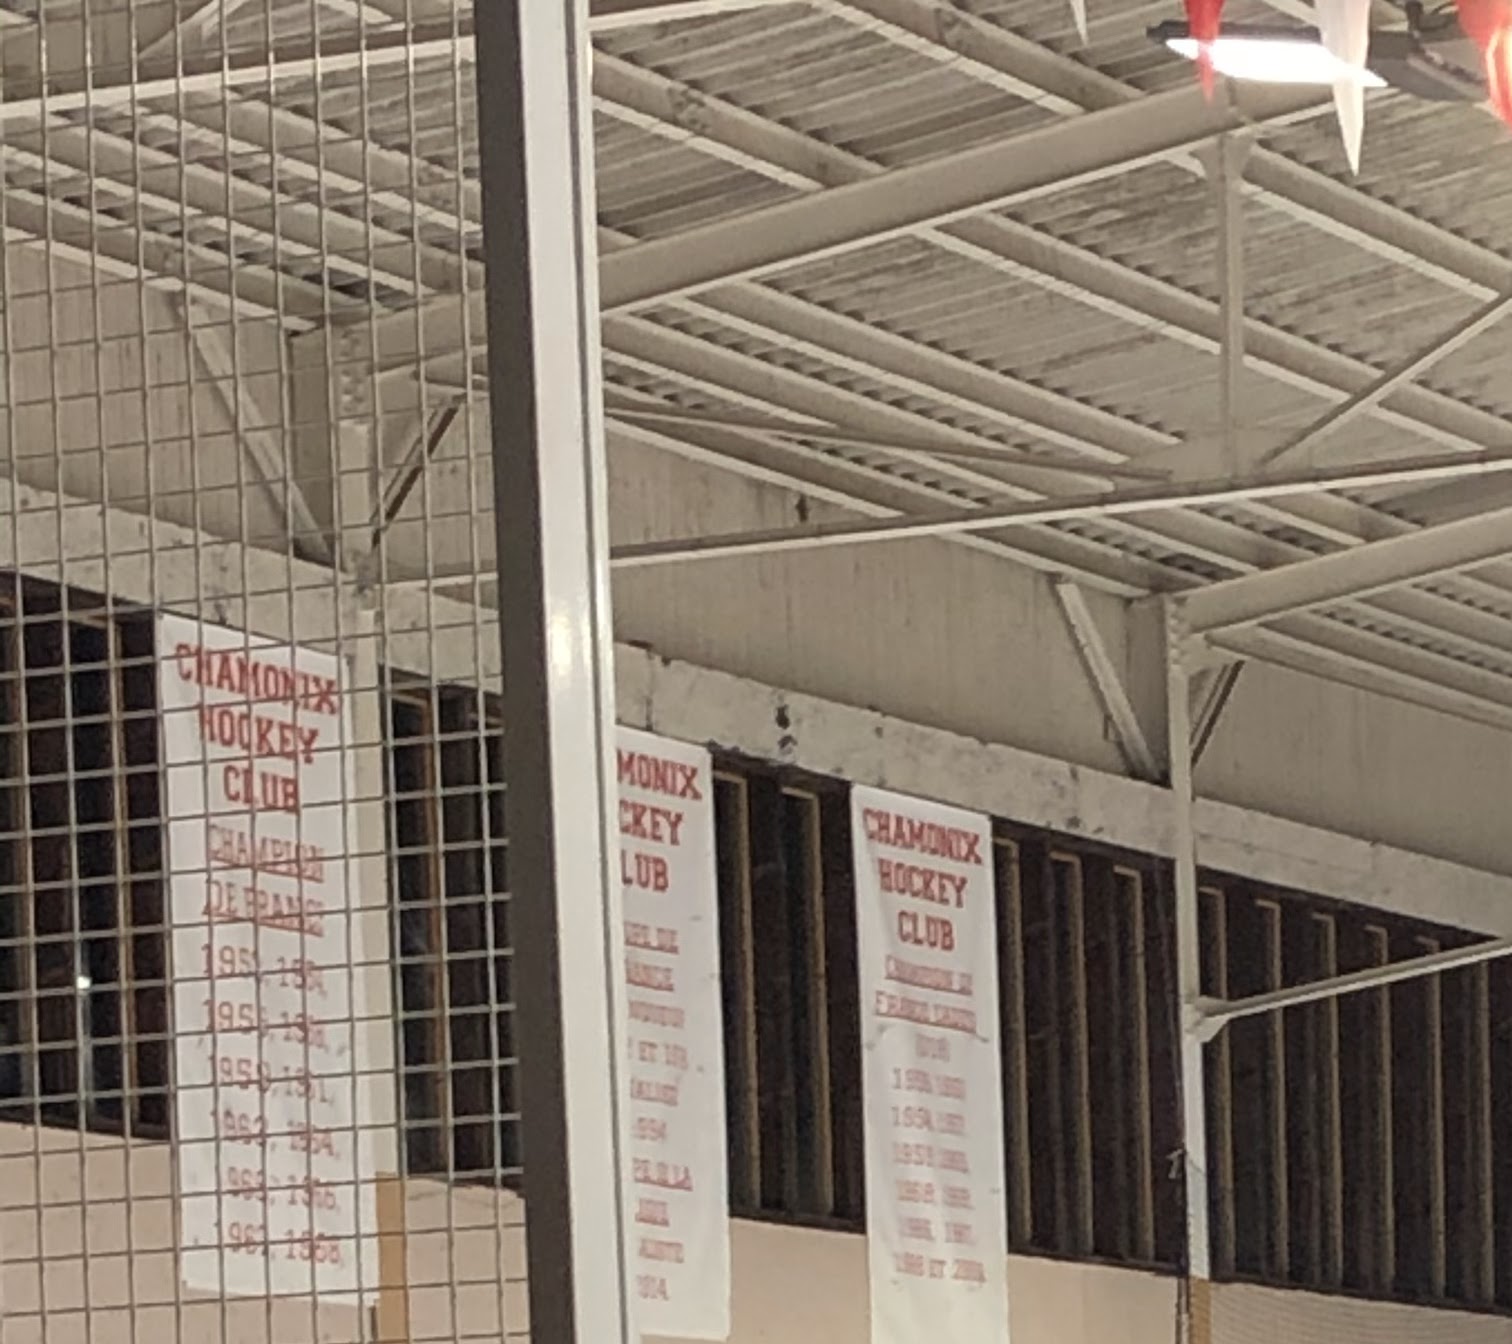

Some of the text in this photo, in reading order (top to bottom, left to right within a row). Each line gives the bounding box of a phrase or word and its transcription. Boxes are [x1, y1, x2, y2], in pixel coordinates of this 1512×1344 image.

[175, 643, 338, 715] CHAMONIX
[200, 706, 319, 764] HOCKEY
[223, 764, 299, 815] CLUB
[863, 807, 984, 865] CHAMONIX
[878, 857, 968, 909] HOCKEY
[898, 909, 955, 952] CLUB
